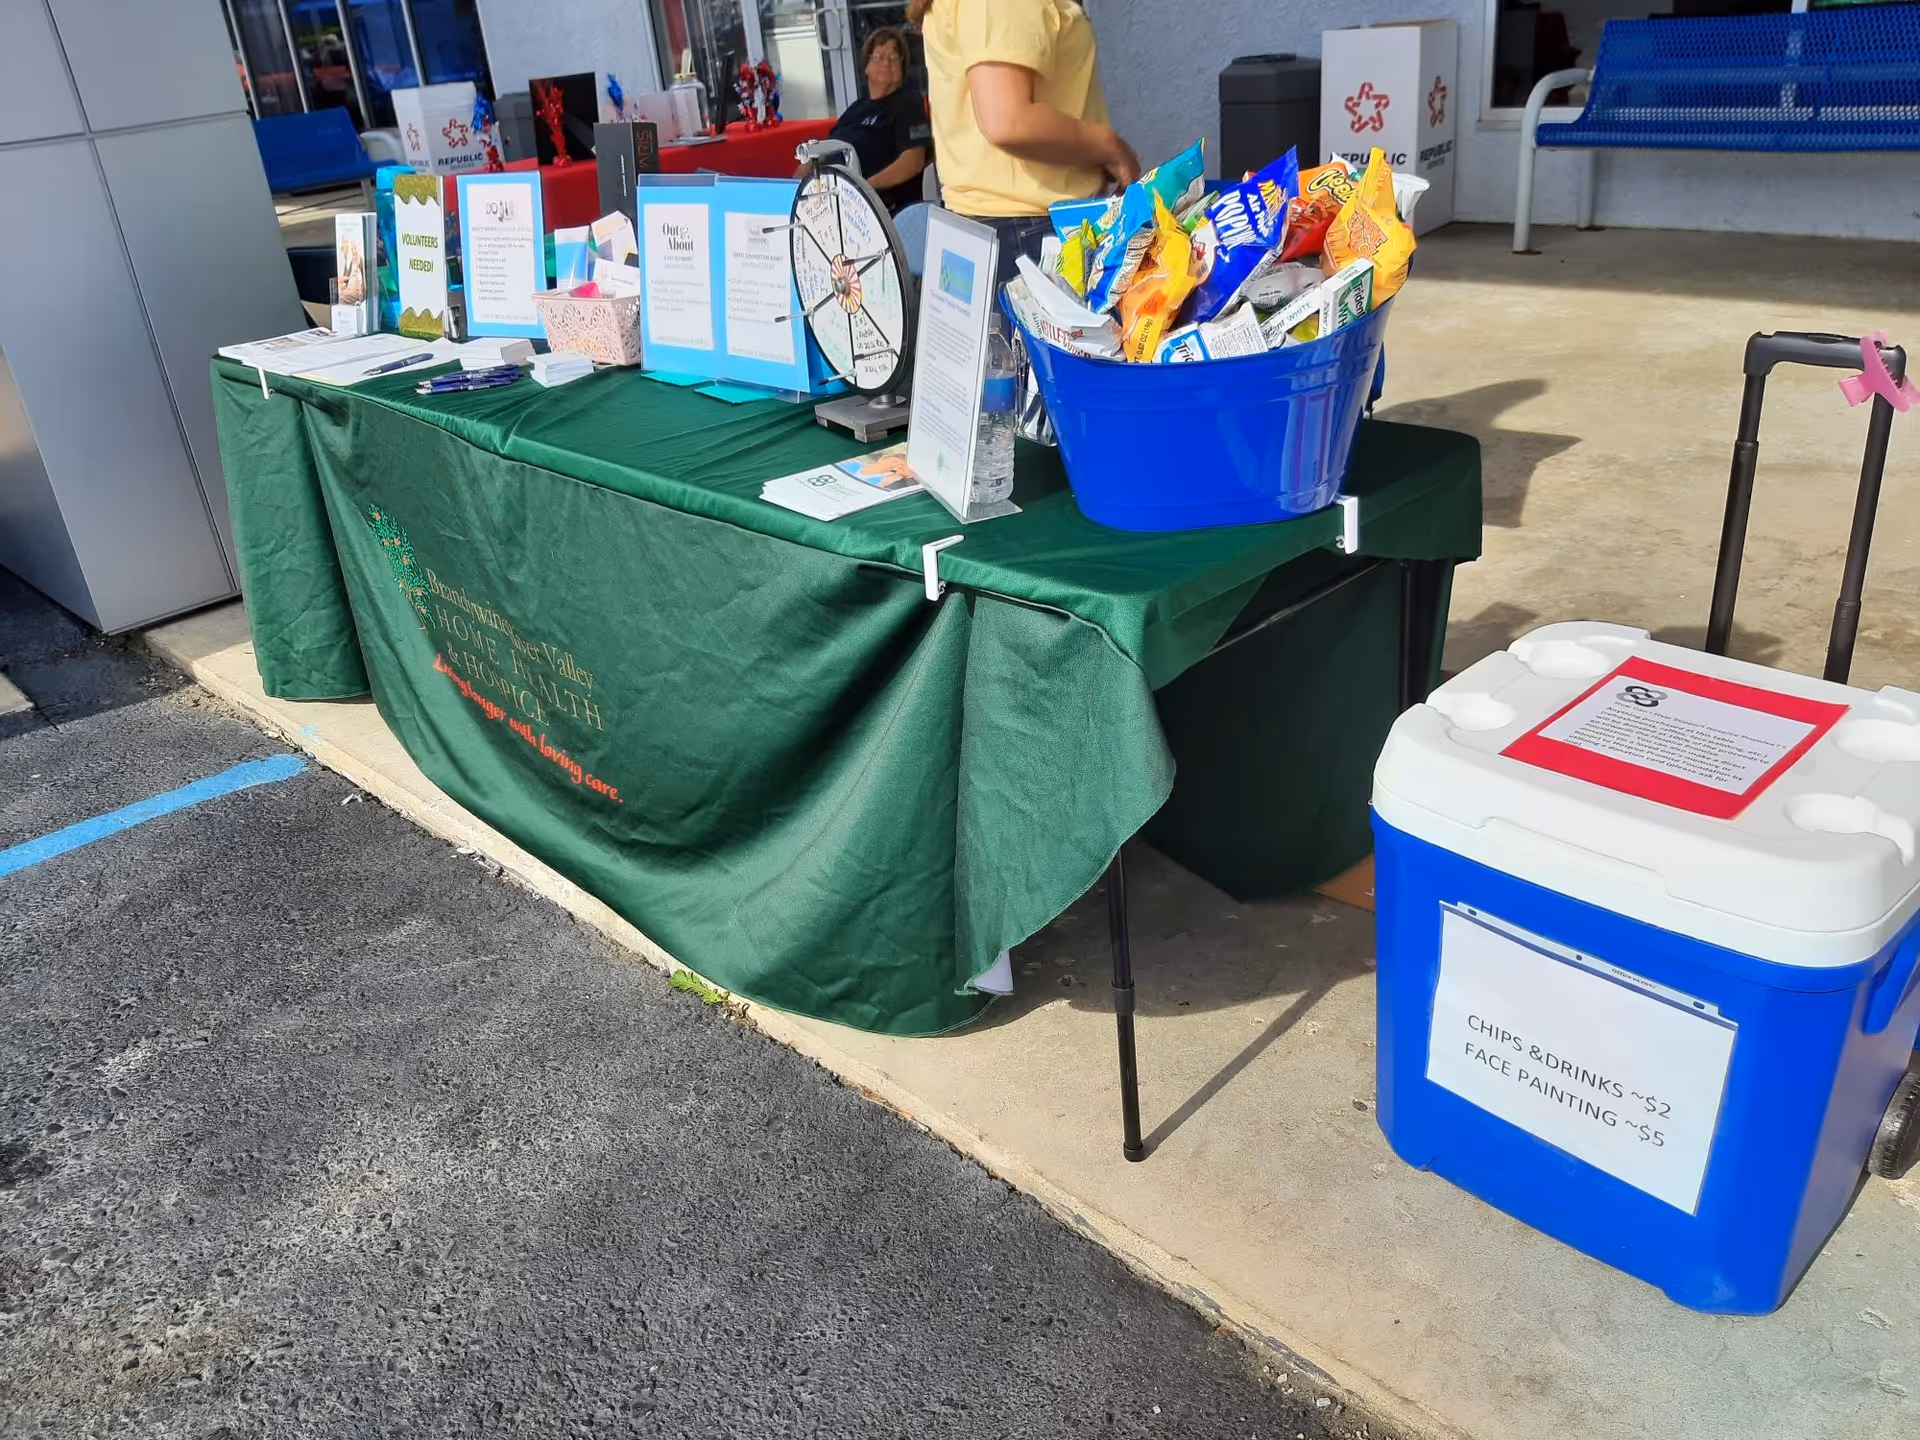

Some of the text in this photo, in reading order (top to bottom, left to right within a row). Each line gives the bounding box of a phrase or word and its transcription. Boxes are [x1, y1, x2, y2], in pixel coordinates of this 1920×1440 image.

[438, 152, 484, 166] REPUBLIC
[402, 233, 438, 248] VOLUNTEERS
[662, 222, 679, 236] Out
[668, 237, 694, 251] About
[409, 258, 434, 272] NEEDED!
[426, 568, 512, 636] Brandywine
[541, 642, 593, 690] Valley
[434, 604, 500, 665] HOME
[447, 642, 462, 668] &
[1606, 707, 1641, 718] Anything
[1643, 717, 1684, 730] purchased
[1707, 727, 1739, 736] Hospice
[466, 680, 507, 720] longer
[509, 718, 538, 746] with
[540, 733, 583, 784] loving
[585, 773, 624, 804] care.
[1581, 727, 1616, 738] donation
[1685, 756, 1720, 768] memory
[1624, 722, 1656, 732] donated
[1719, 748, 1757, 761] proceeds
[1651, 736, 1683, 746] Hospice
[1685, 745, 1719, 756] Promise
[1608, 746, 1644, 758] donation
[1667, 762, 1697, 773] (please
[1613, 742, 1644, 752] Hospice
[1647, 751, 1680, 762] Promise
[1682, 761, 1730, 776] Foundation
[1468, 1014, 1672, 1119] CHIPS &DRINKS ~$2
[1465, 1042, 1665, 1147] FACE PAINTING ~$5
